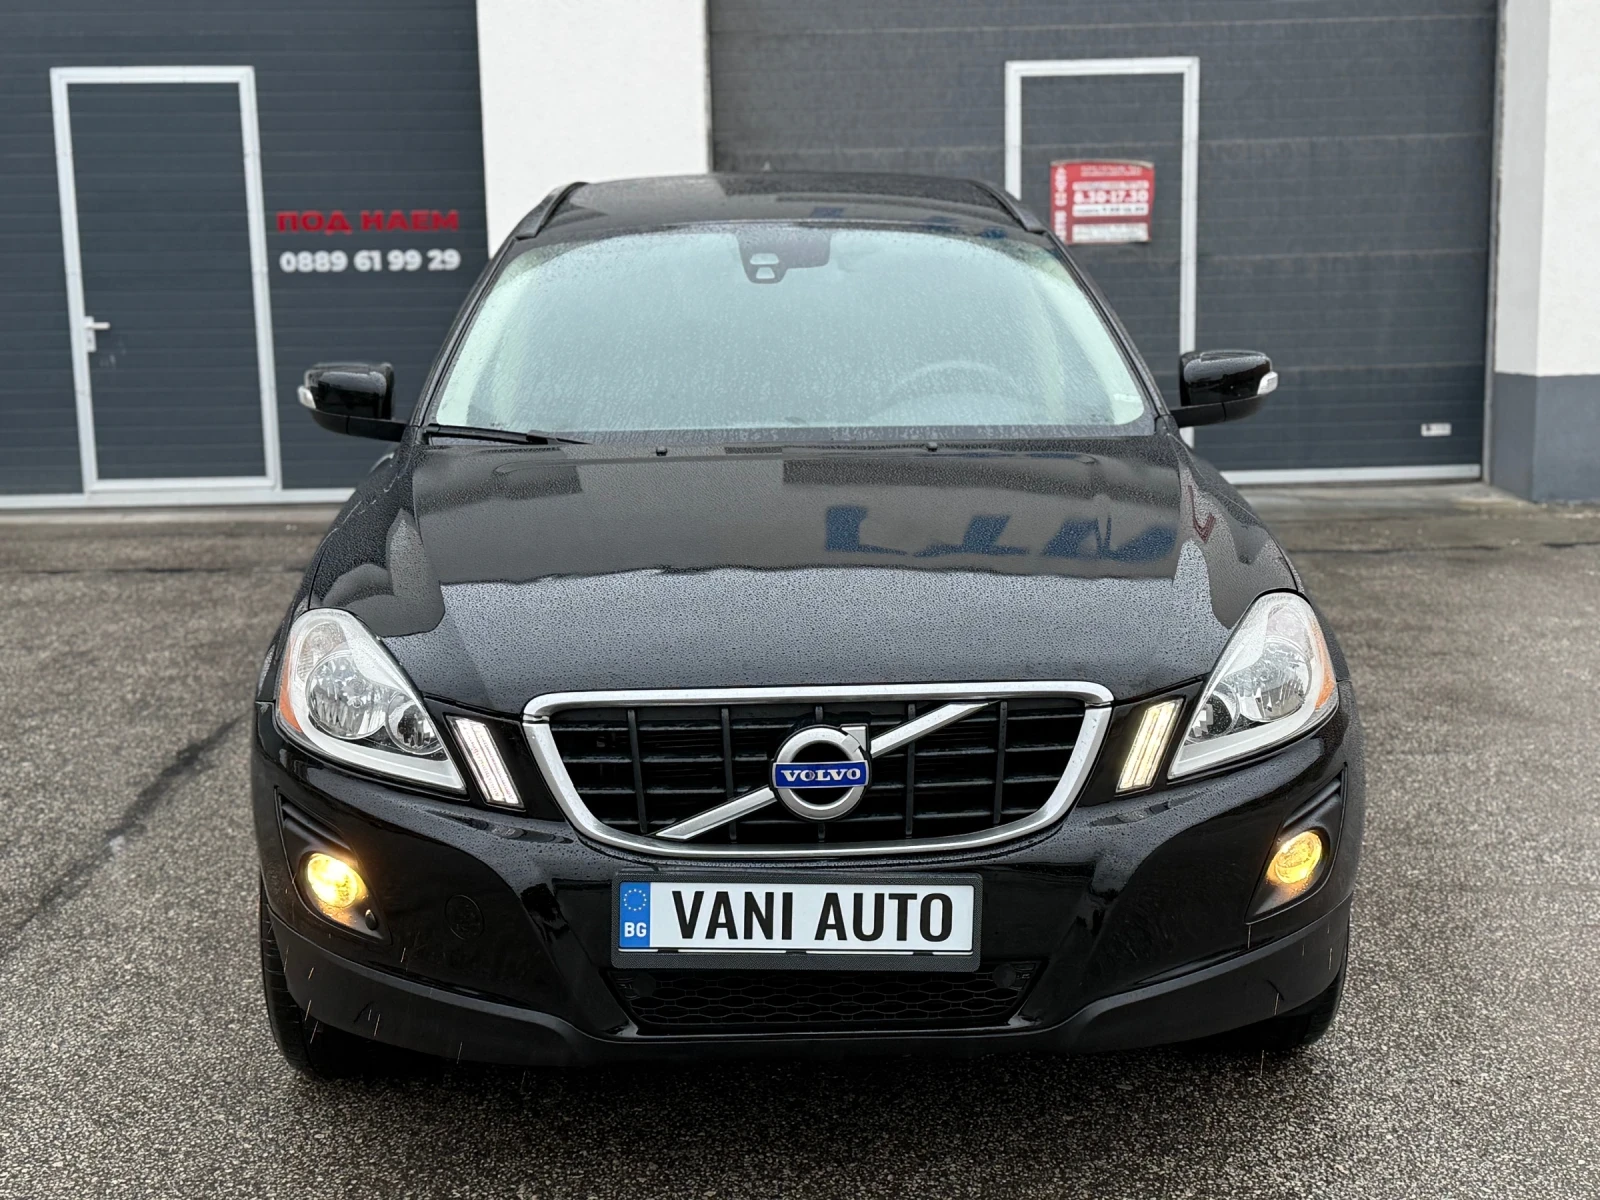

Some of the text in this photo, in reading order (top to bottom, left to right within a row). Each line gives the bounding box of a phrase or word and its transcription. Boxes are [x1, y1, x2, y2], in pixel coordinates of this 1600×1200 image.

[276, 210, 460, 235] ПОД НАЕМ
[279, 248, 462, 273] 0889 61 99 29
[780, 768, 861, 782] VOLVO
[672, 890, 953, 943] VANI AUTO
[624, 922, 647, 938] BG
